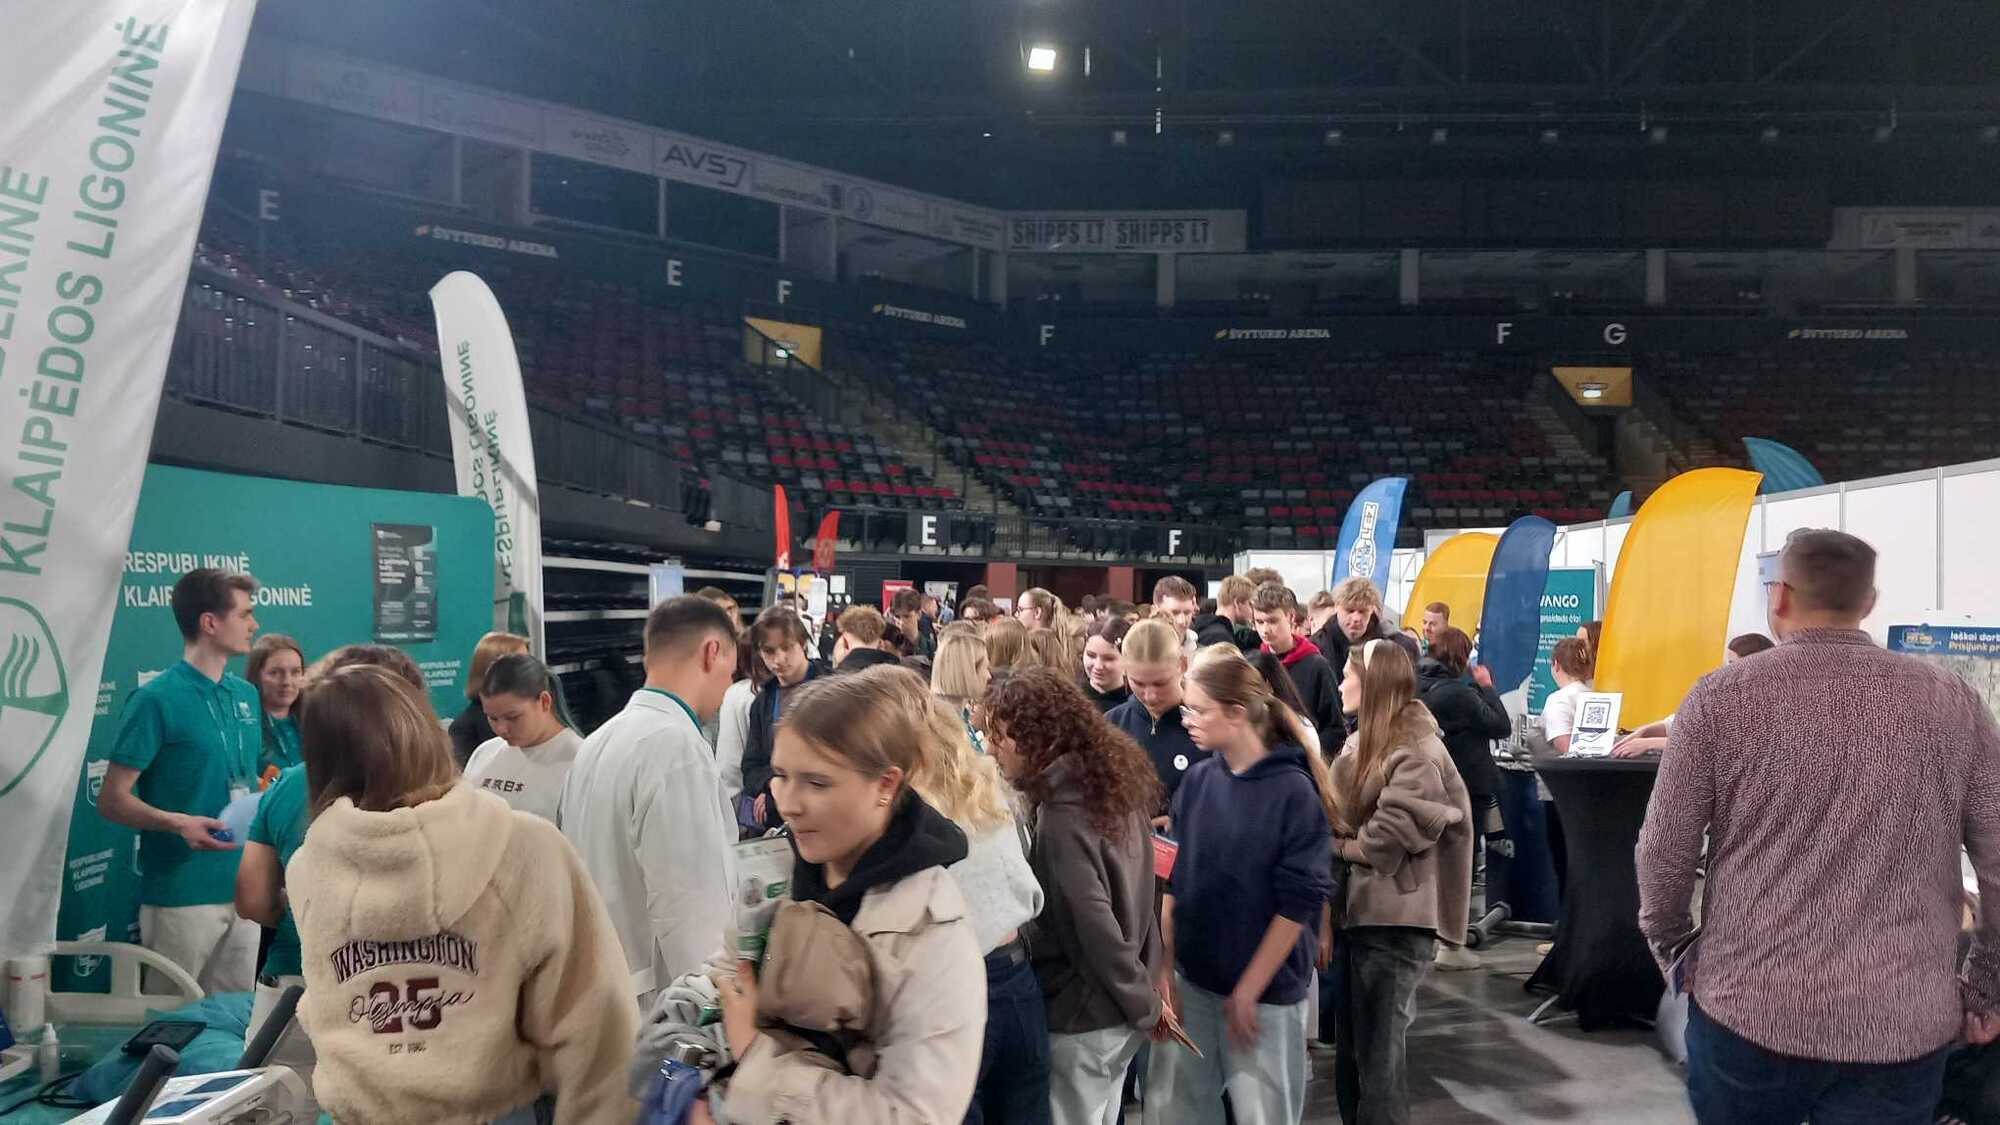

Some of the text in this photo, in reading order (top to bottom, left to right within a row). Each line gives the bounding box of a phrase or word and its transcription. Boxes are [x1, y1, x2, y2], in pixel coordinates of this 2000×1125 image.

[260, 189, 279, 220] E
[1117, 222, 1185, 244] SHIPPS
[667, 259, 683, 286] E
[0, 16, 169, 575] KLAIPĖDOS LIGONINĖ
[777, 280, 792, 304] F
[1040, 325, 1055, 345] F
[1496, 323, 1513, 345] F
[1603, 323, 1628, 345] G
[921, 515, 937, 546] E
[1168, 529, 1183, 555] F
[330, 931, 479, 984] WASHINGTON
[369, 977, 442, 1033] 25
